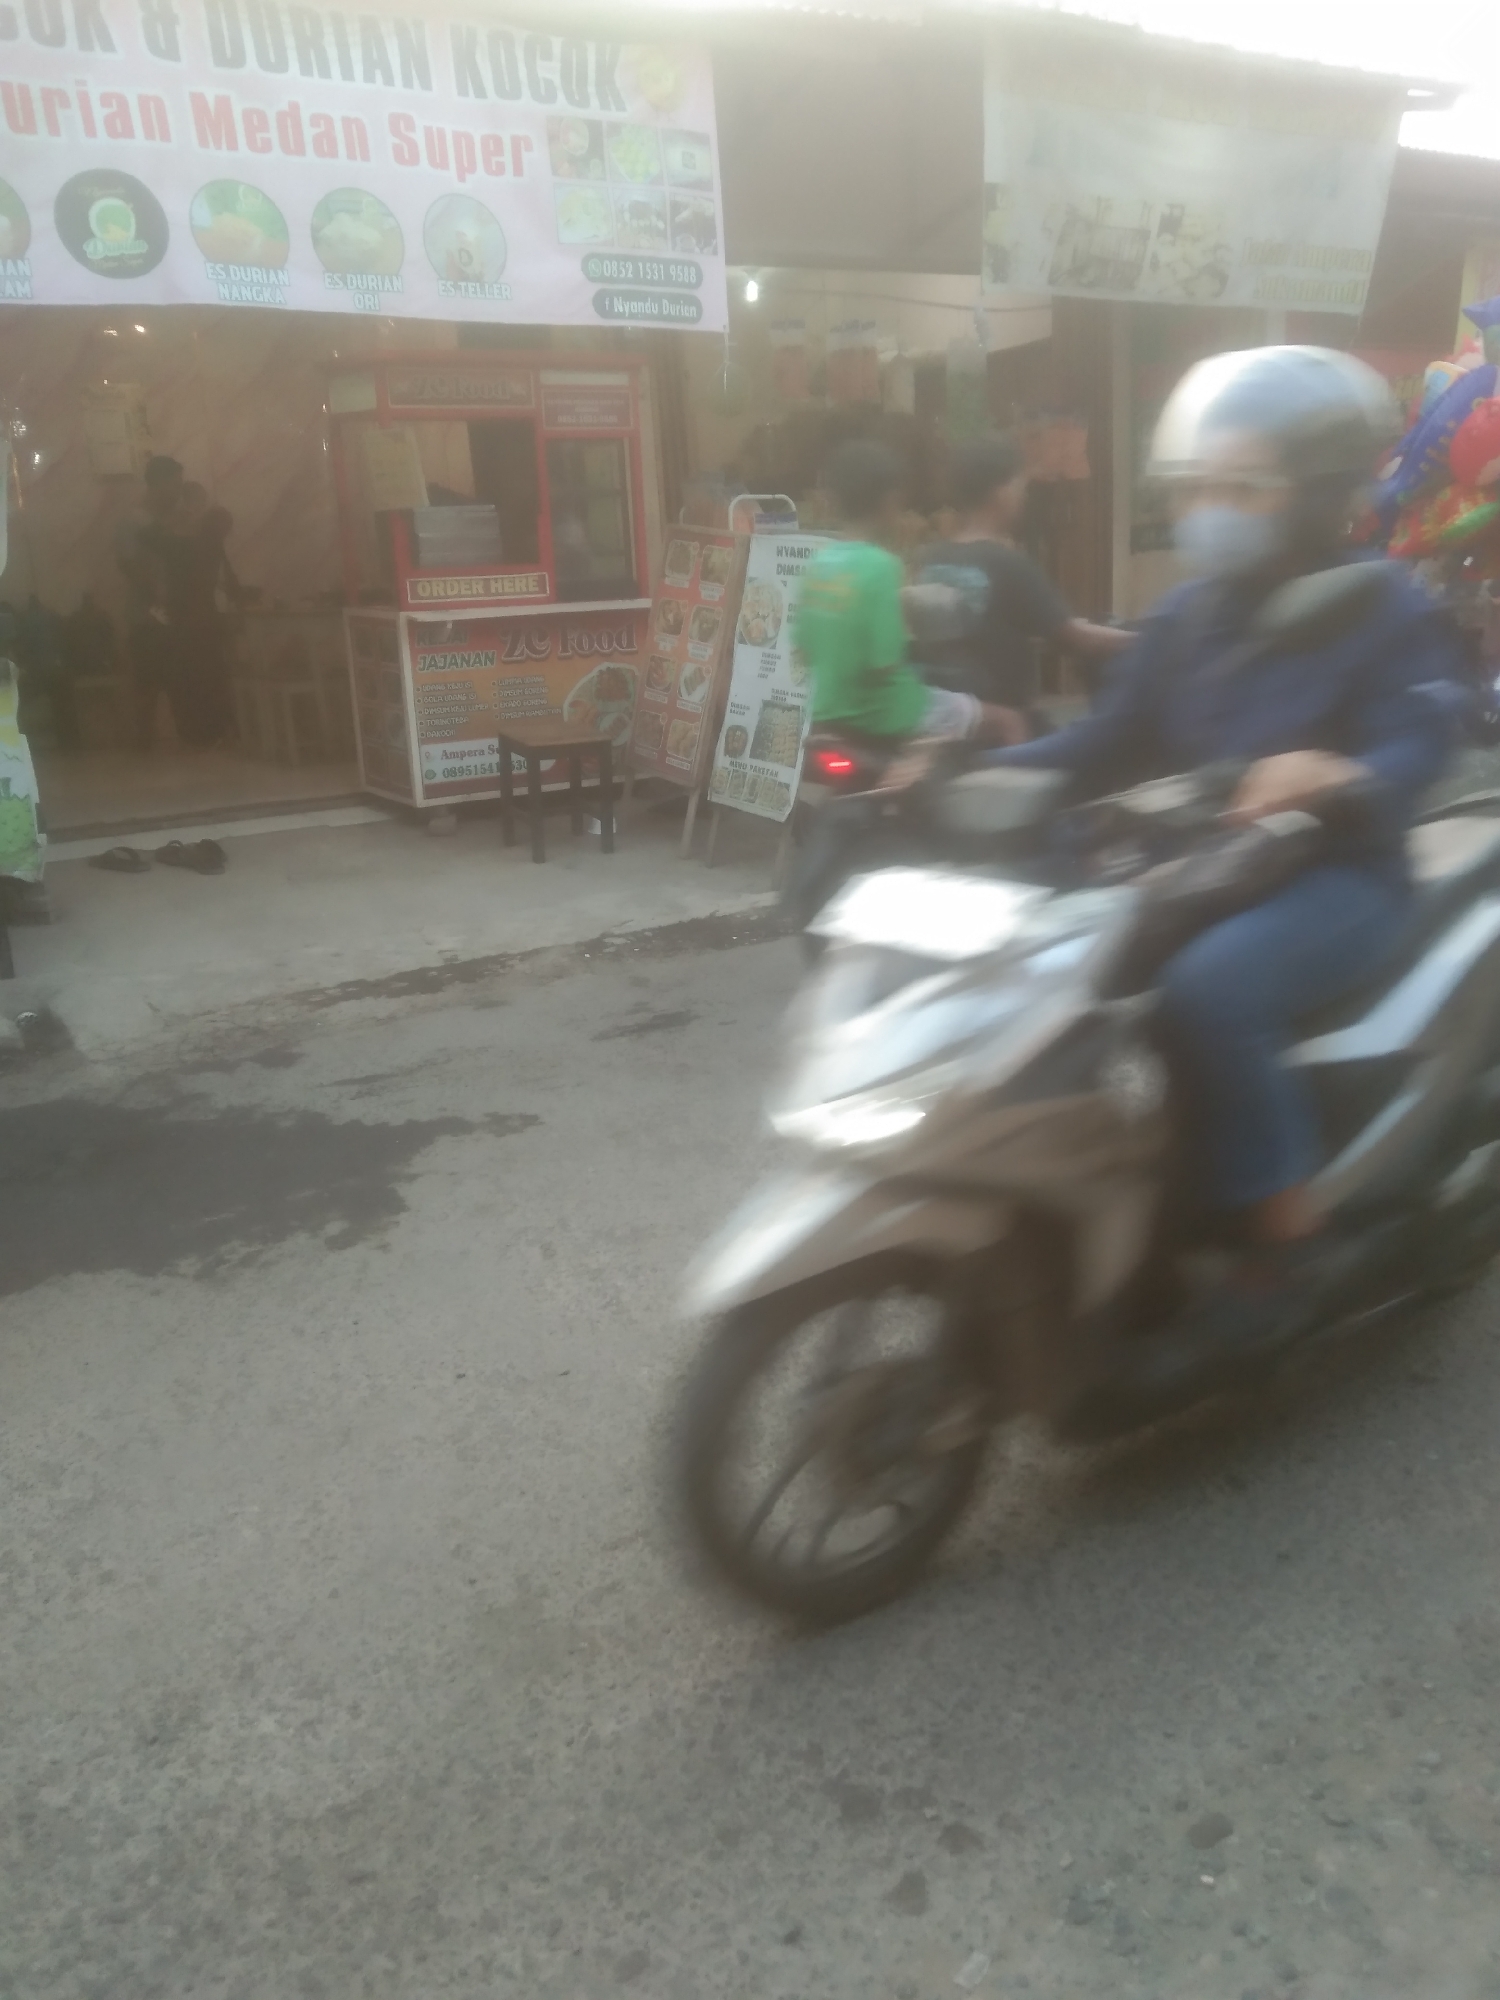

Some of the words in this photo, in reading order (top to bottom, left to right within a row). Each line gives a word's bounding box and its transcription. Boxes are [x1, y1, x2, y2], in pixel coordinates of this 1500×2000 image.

[139, 0, 182, 63] &
[203, 0, 434, 92] DURIAN
[449, 22, 628, 113] KOCOK
[188, 91, 371, 162] Medan
[387, 112, 534, 184] Super
[0, 258, 32, 277] AN
[206, 262, 226, 281] ES
[230, 265, 290, 286] DURIAN
[603, 260, 633, 278] 0852
[638, 262, 664, 281] 1531
[669, 264, 697, 283] 9588
[0, 280, 32, 299] AM
[324, 272, 344, 290] ES
[346, 273, 404, 292] DURIAN
[437, 279, 457, 297] ES
[458, 281, 513, 299] TELLER
[217, 283, 288, 304] NANGKA
[353, 293, 380, 310] ORI
[613, 296, 658, 317] Nyandu
[662, 298, 697, 318] Durian
[417, 578, 485, 598] ORDER
[489, 575, 540, 594] HERE
[557, 623, 638, 661] Food
[417, 649, 497, 673] JAJANAN
[440, 748, 485, 760] Ampera
